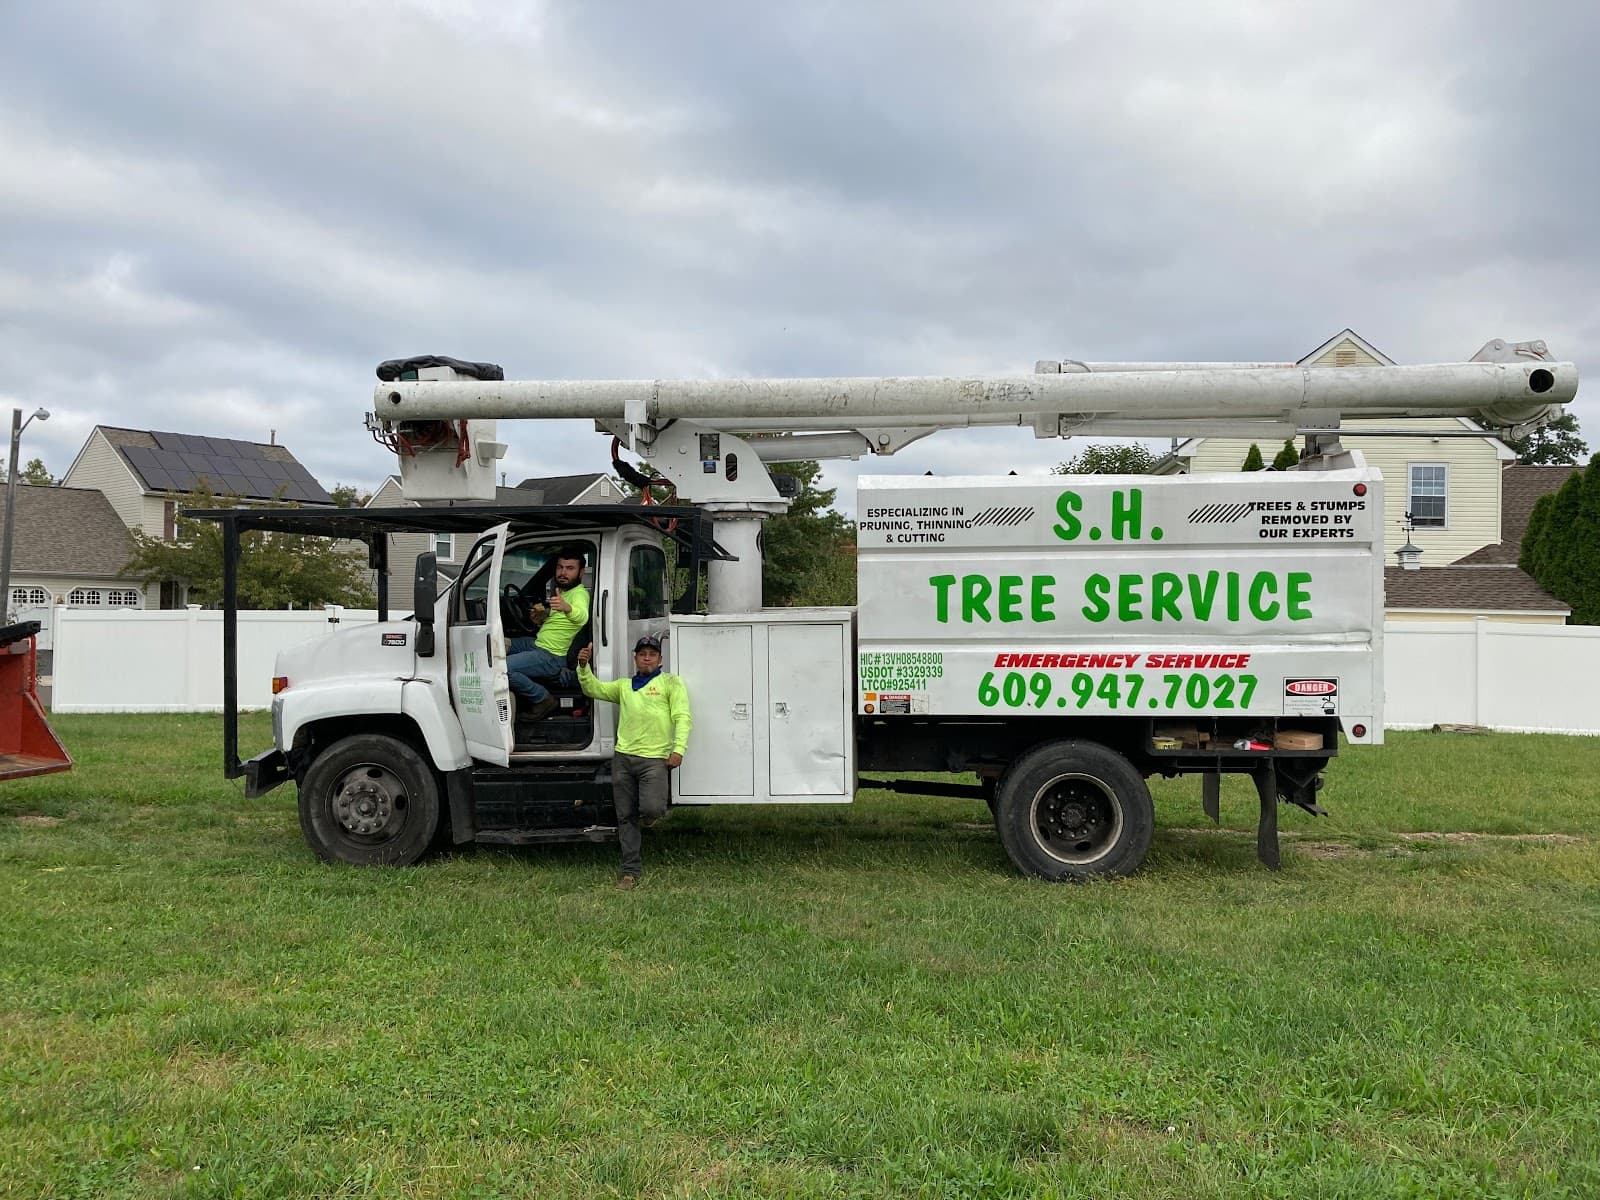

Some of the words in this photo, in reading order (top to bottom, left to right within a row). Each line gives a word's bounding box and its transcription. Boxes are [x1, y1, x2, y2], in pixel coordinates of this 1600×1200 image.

[1249, 502, 1291, 511] TREES
[1296, 501, 1306, 511] &
[1310, 500, 1366, 511] STUMPS
[867, 507, 949, 518] ESPECIALIZING
[951, 506, 964, 516] IN
[1053, 489, 1163, 540] S.H.
[859, 520, 913, 531] PRUNING,
[917, 520, 972, 530] THINNING
[1261, 514, 1329, 525] REMOVED
[1333, 514, 1353, 525] BY
[885, 533, 894, 544] &
[897, 533, 945, 543] CUTTING
[1258, 528, 1289, 539] OUR
[1292, 528, 1354, 538] EXPERTS
[929, 575, 1055, 622] TREE
[1081, 571, 1311, 621] SERVICE
[994, 653, 1139, 668] EMERGENCY
[1145, 654, 1249, 669] SERVICE
[860, 666, 894, 678] USDOT
[896, 666, 943, 678] #3329339
[861, 679, 926, 691] LTCO#925411
[978, 673, 1257, 709] 609.947.7027
[1295, 683, 1328, 692] DANGER
